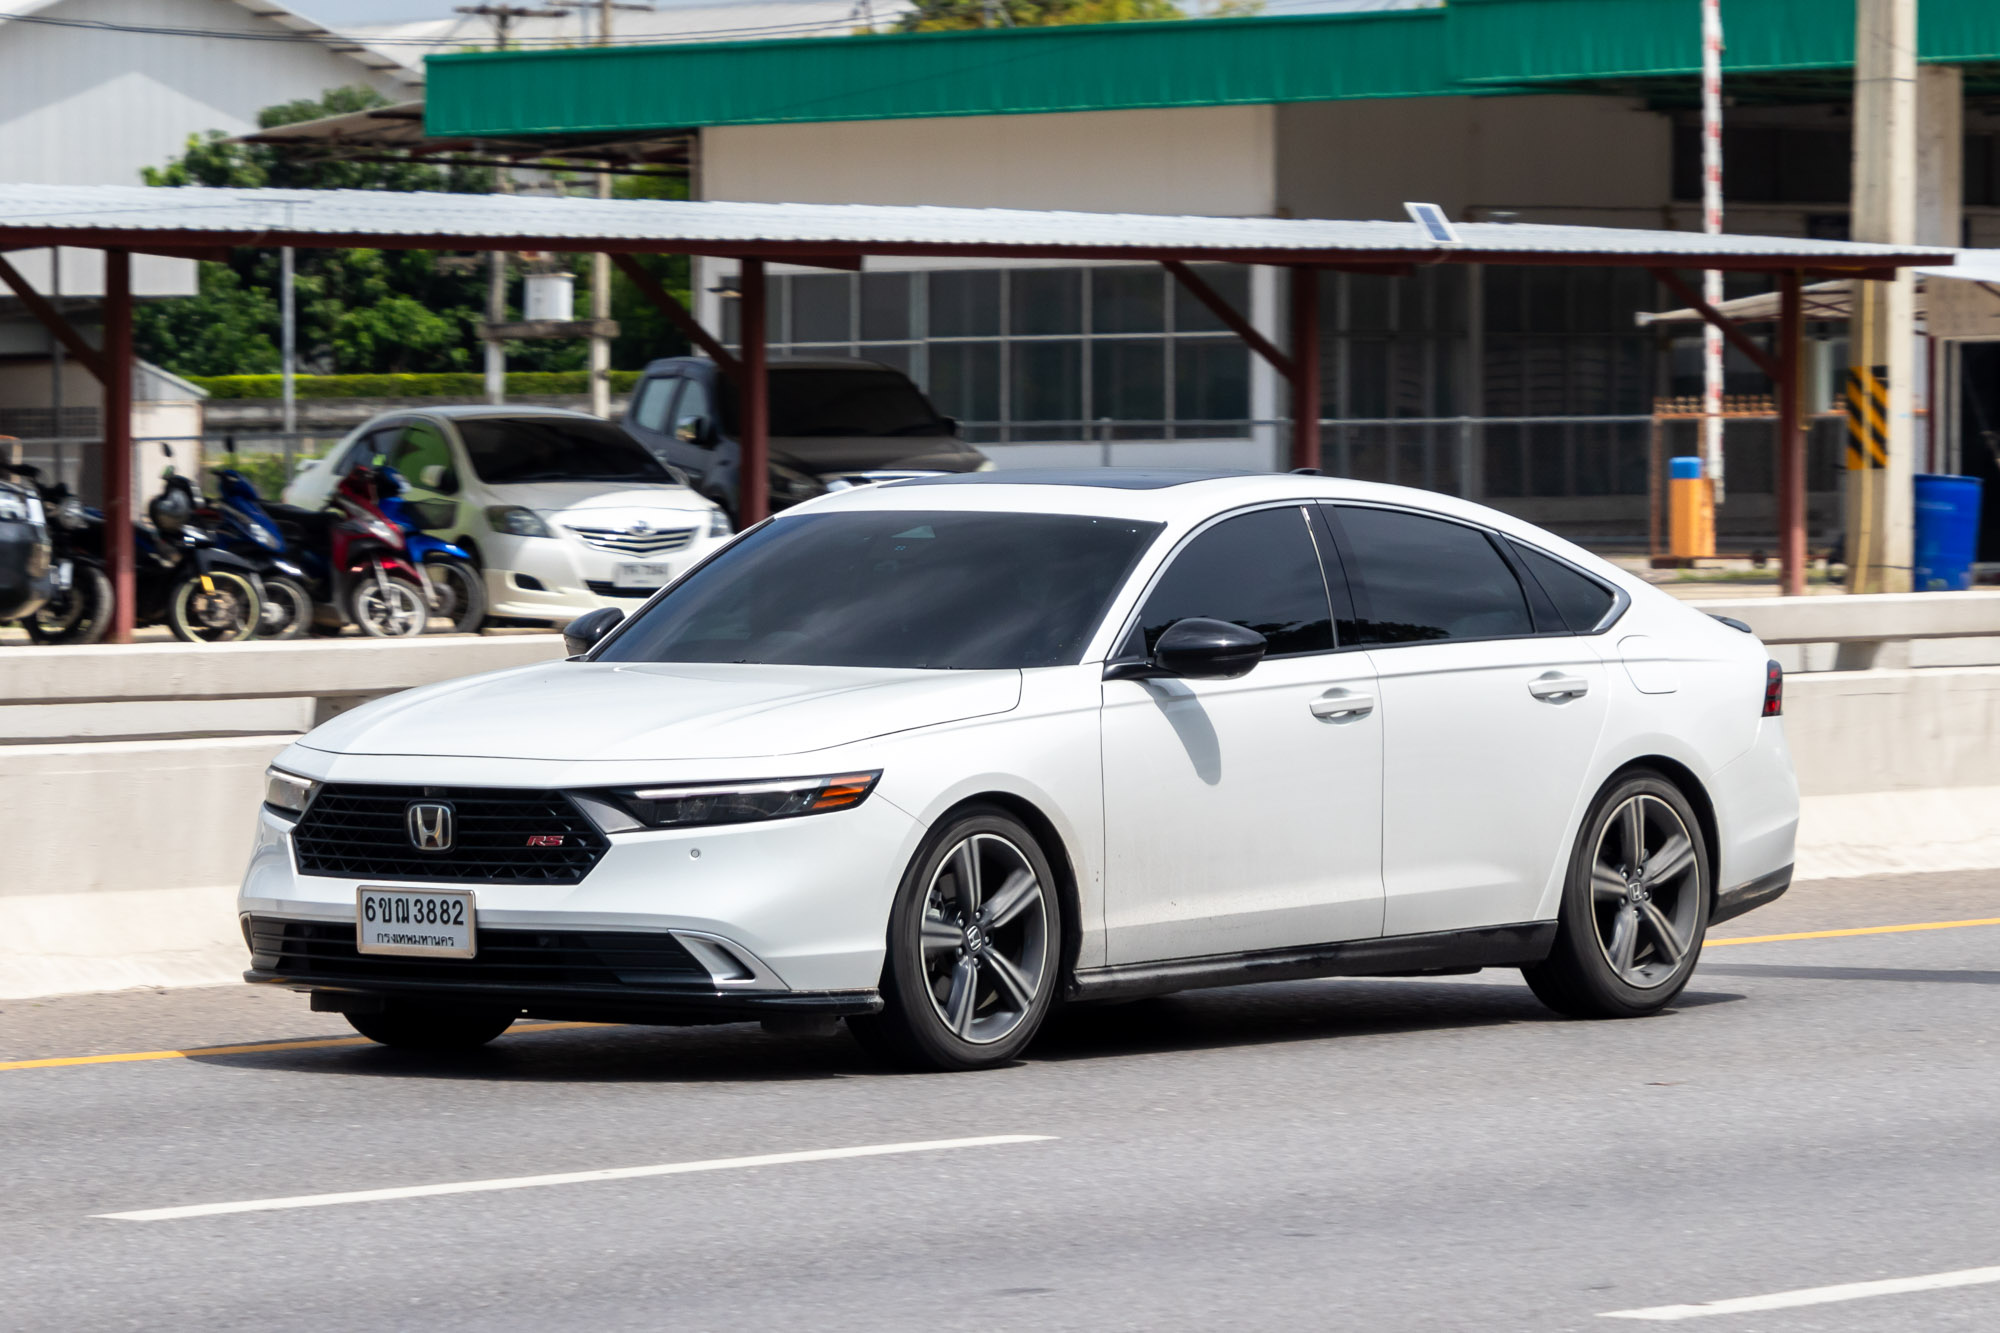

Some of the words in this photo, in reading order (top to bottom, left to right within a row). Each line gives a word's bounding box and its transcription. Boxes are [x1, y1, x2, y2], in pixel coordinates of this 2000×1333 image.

[526, 835, 565, 847] RS
[376, 932, 455, 947] กรงเทพมหานคร
